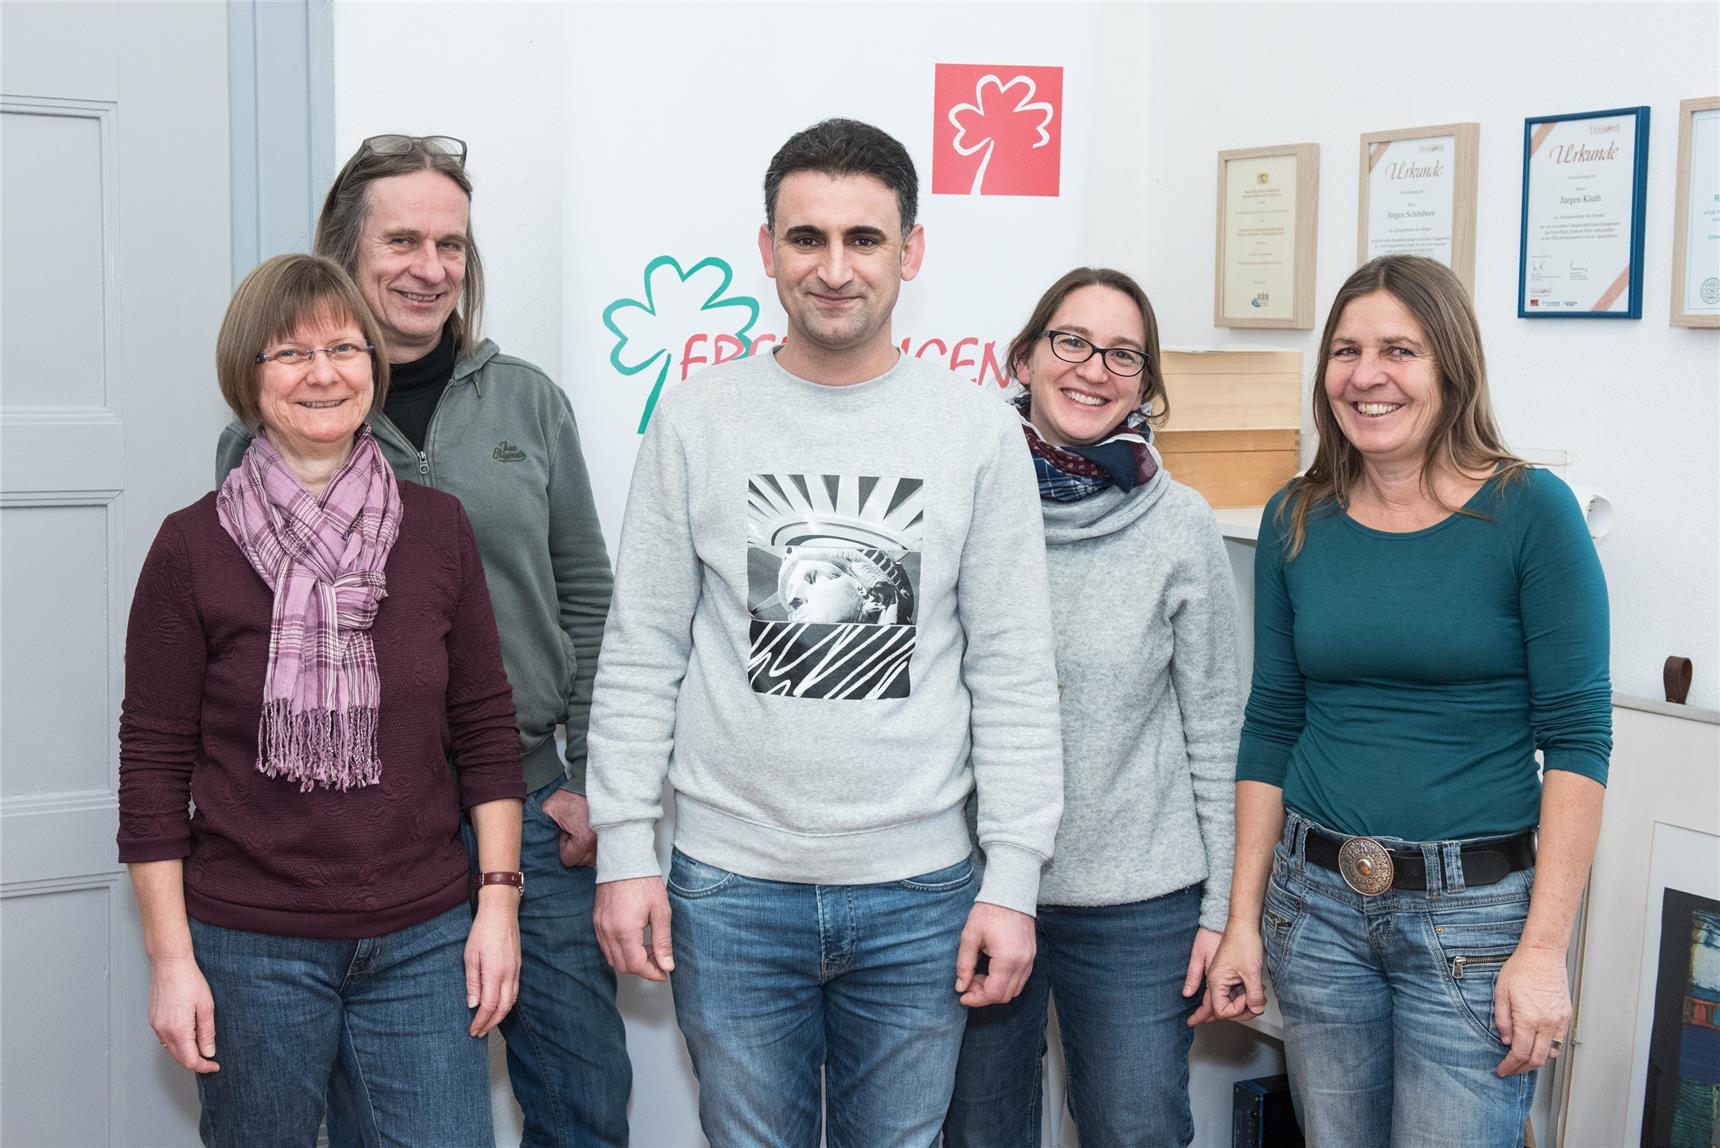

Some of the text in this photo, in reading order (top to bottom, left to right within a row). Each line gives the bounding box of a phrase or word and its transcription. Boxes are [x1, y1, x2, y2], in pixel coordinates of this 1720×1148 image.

[1549, 141, 1619, 164] Urkunde
[1385, 160, 1444, 180] Urkunde
[1560, 196, 1582, 206] Jürgen
